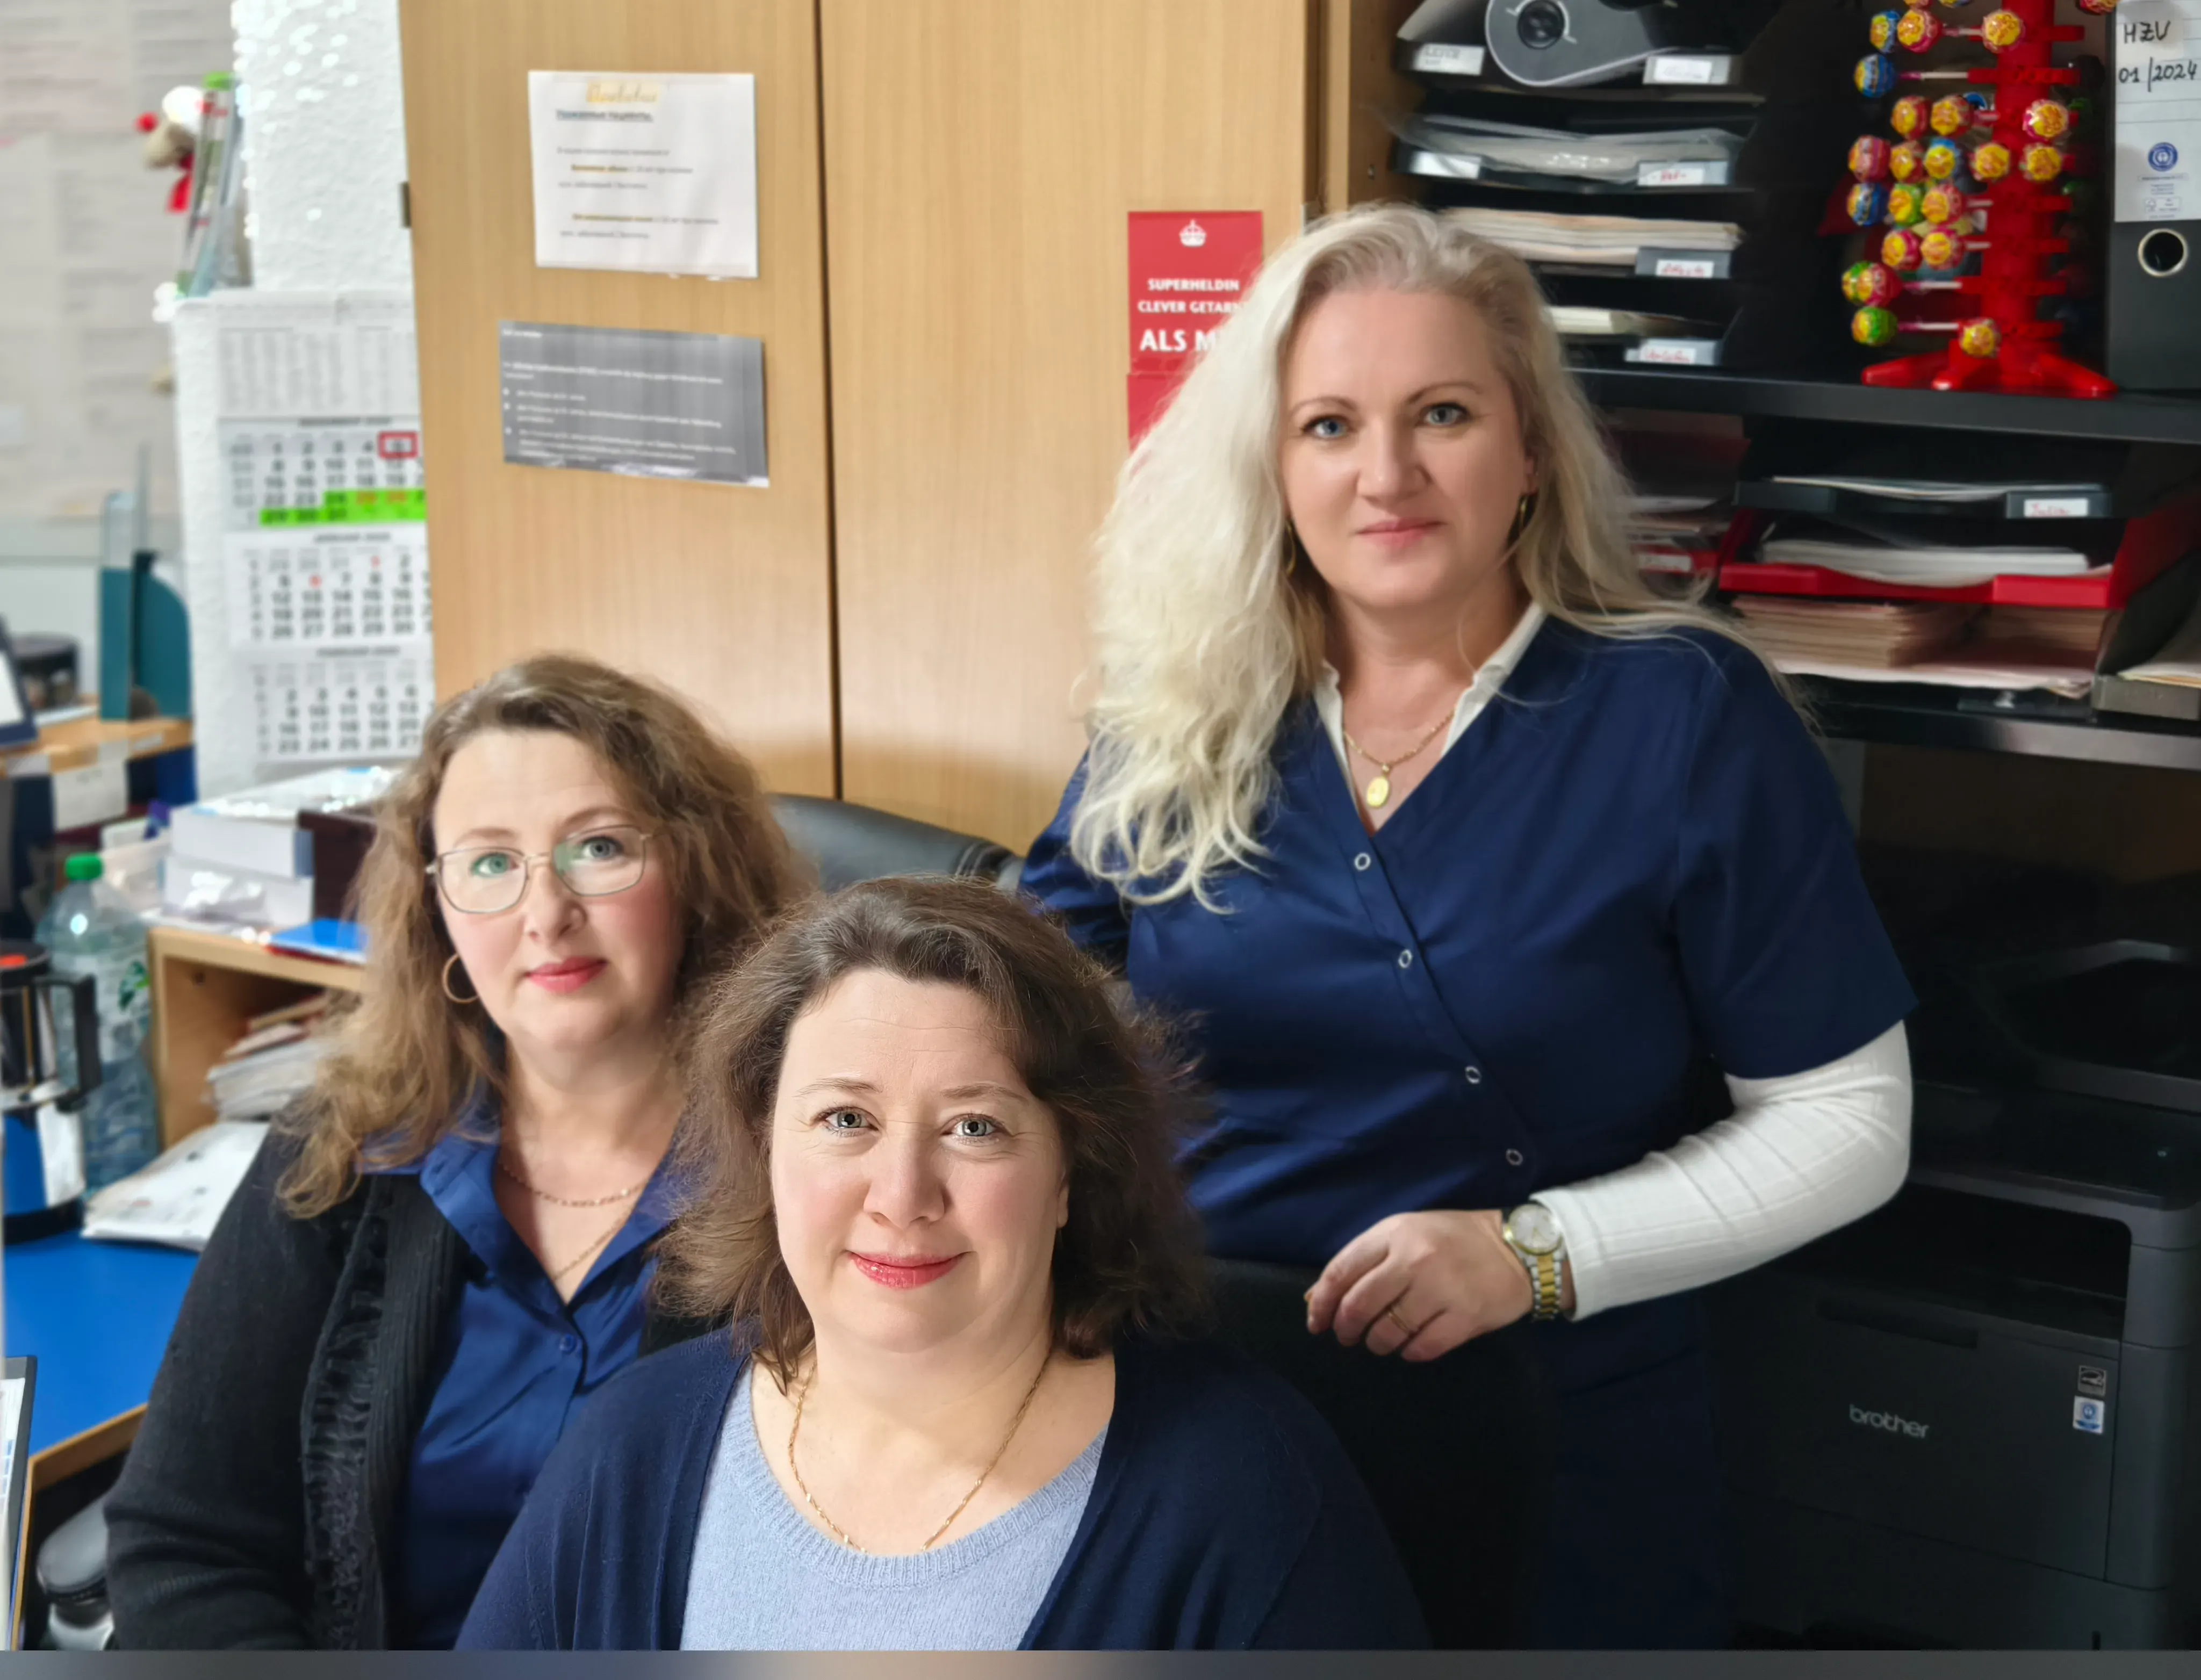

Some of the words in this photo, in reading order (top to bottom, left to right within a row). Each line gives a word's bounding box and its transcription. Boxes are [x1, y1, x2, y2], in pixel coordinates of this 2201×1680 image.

[2123, 20, 2171, 44] HZV
[1148, 278, 1239, 291] SUPERHELDIN
[1138, 301, 1185, 313] CLEVER
[1190, 301, 1240, 314] GETAR
[1140, 328, 1186, 352] ALS
[1849, 1404, 1929, 1438] brother
